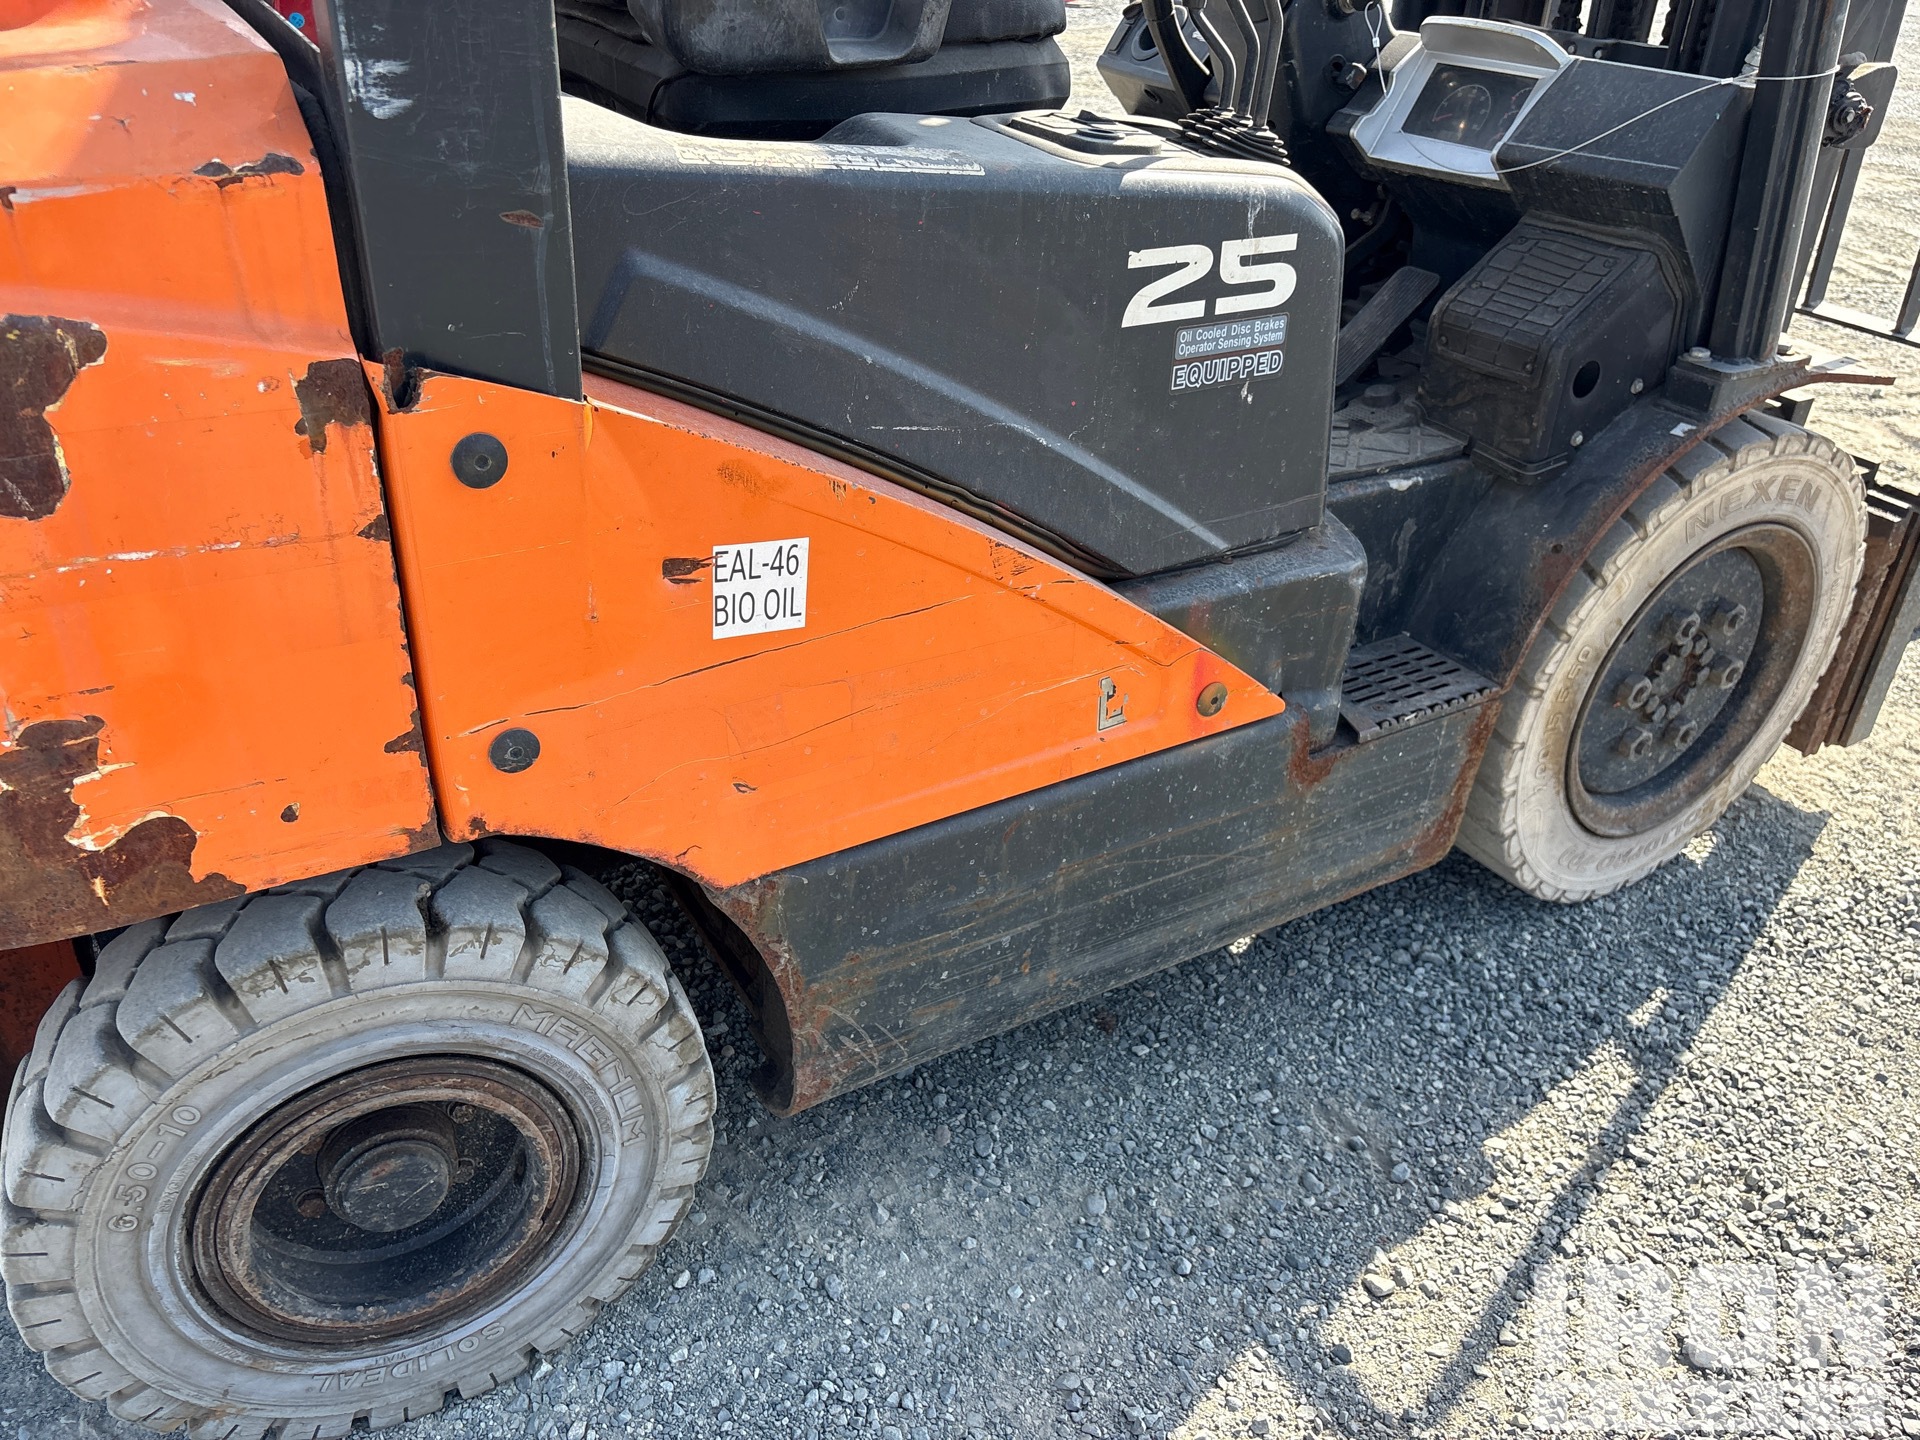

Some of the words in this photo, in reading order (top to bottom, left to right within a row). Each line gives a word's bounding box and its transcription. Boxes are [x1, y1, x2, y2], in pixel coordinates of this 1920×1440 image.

[1121, 233, 1298, 328] 25
[1178, 341, 1216, 357] Operator
[1217, 336, 1251, 350] Sensing
[1253, 330, 1283, 345] System
[1179, 330, 1192, 343] Oil
[1196, 325, 1227, 341] Cooled
[1231, 323, 1251, 336] Disc
[1254, 319, 1285, 333] Brakes
[1171, 350, 1284, 391] EQUIPPED
[1685, 474, 1822, 544] NEXEN
[714, 543, 800, 584] EAL-46
[714, 591, 756, 627] BIO
[764, 586, 802, 621] OIL
[510, 1002, 647, 1148] MAGNUM
[107, 1104, 202, 1233] 6.50-10
[311, 1321, 506, 1394] SOLIDEAL
